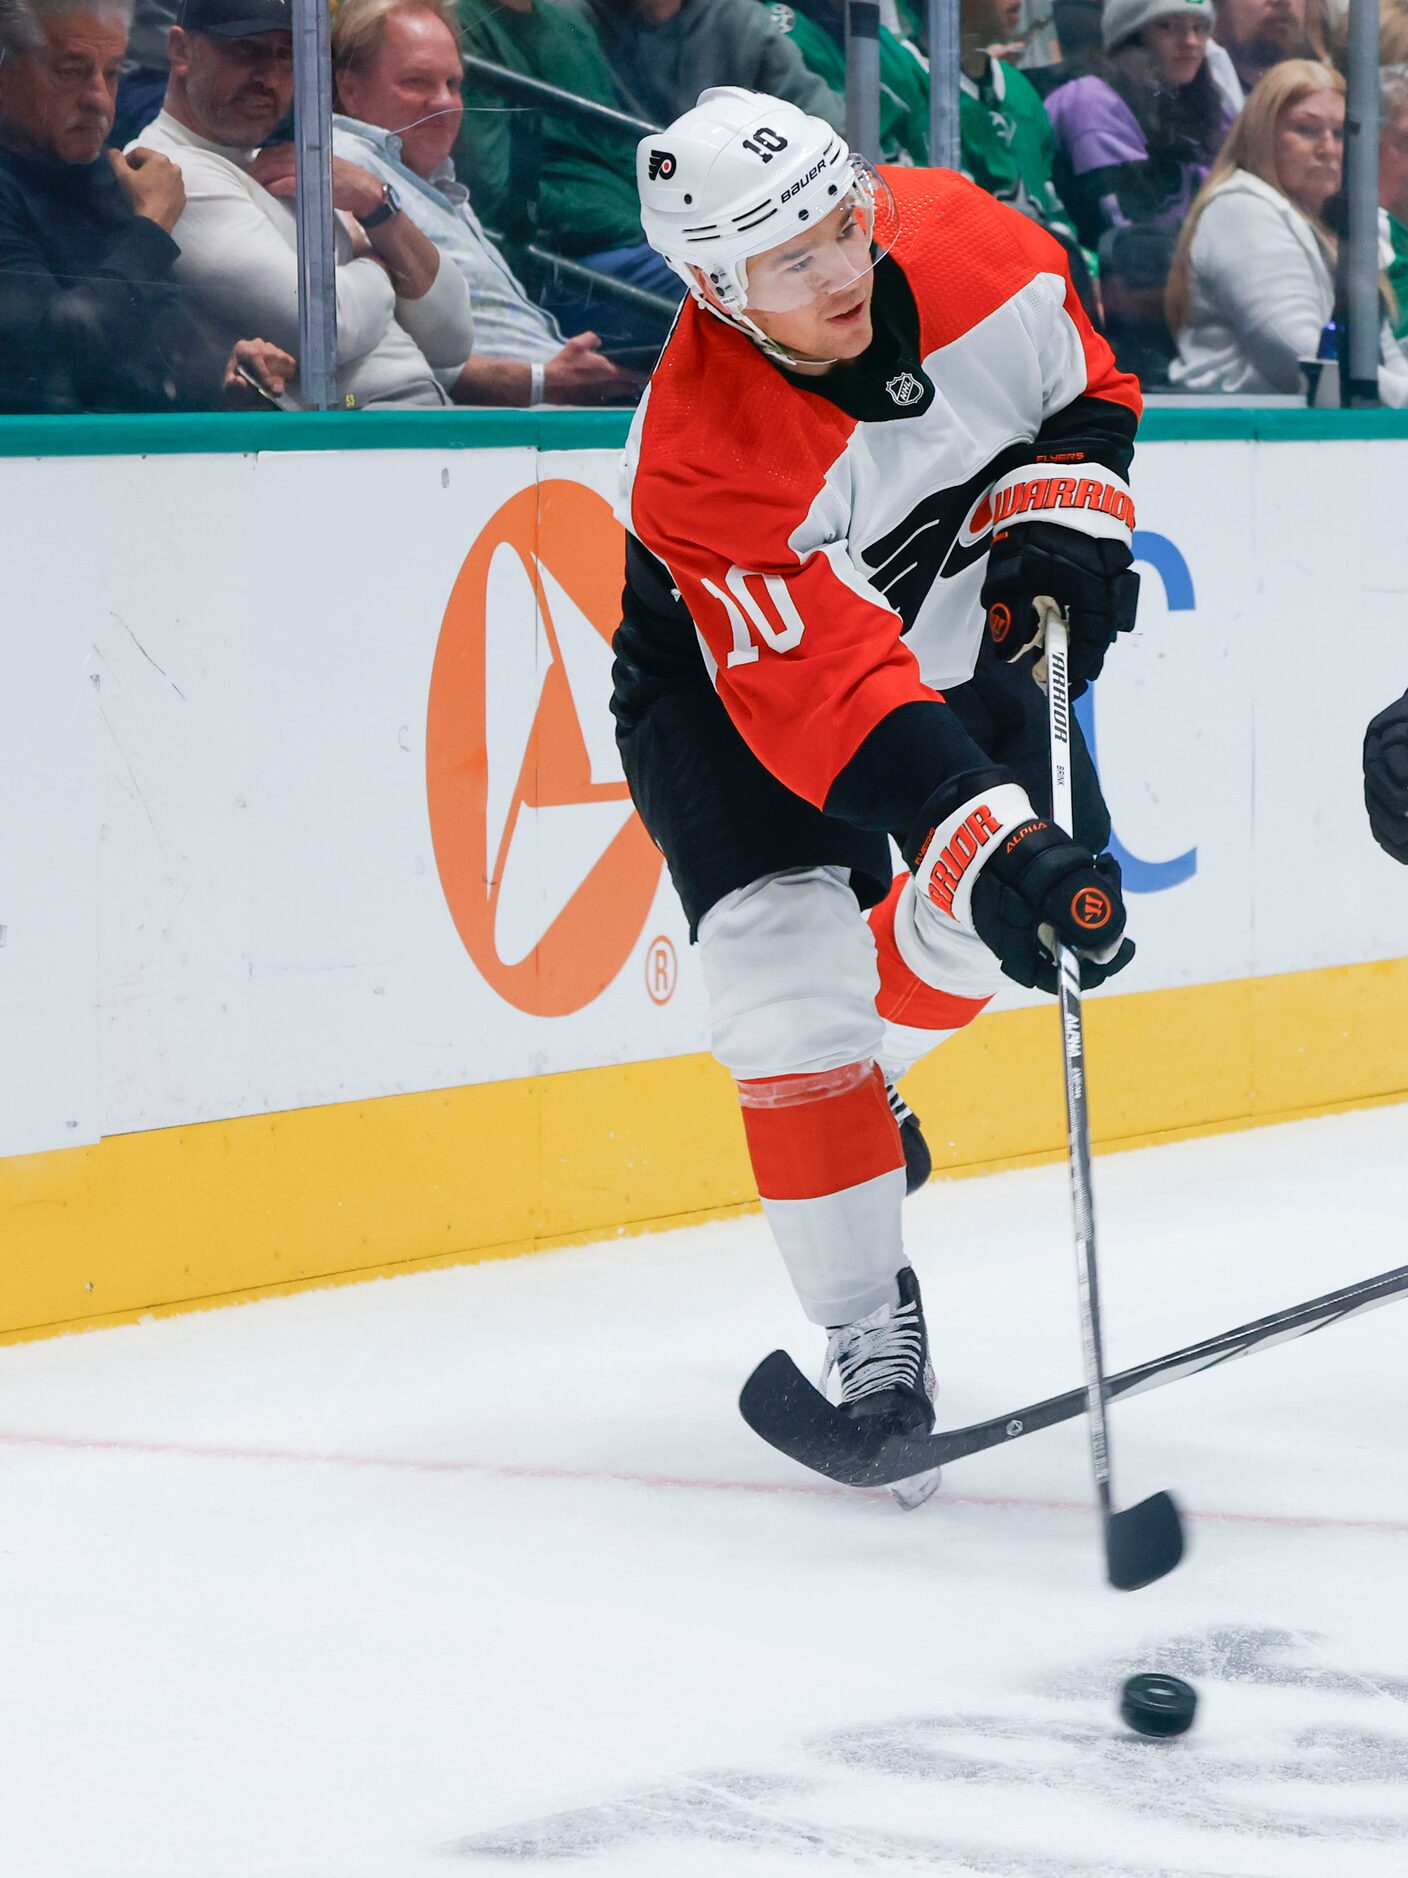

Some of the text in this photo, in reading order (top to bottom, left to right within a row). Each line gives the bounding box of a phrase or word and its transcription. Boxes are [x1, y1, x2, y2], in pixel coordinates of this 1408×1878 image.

[742, 127, 789, 164] 10
[700, 564, 806, 670] 10
[1051, 651, 1068, 744] ARRIOR
[1056, 764, 1065, 787] BRINK
[1006, 821, 1048, 854] ALPHA
